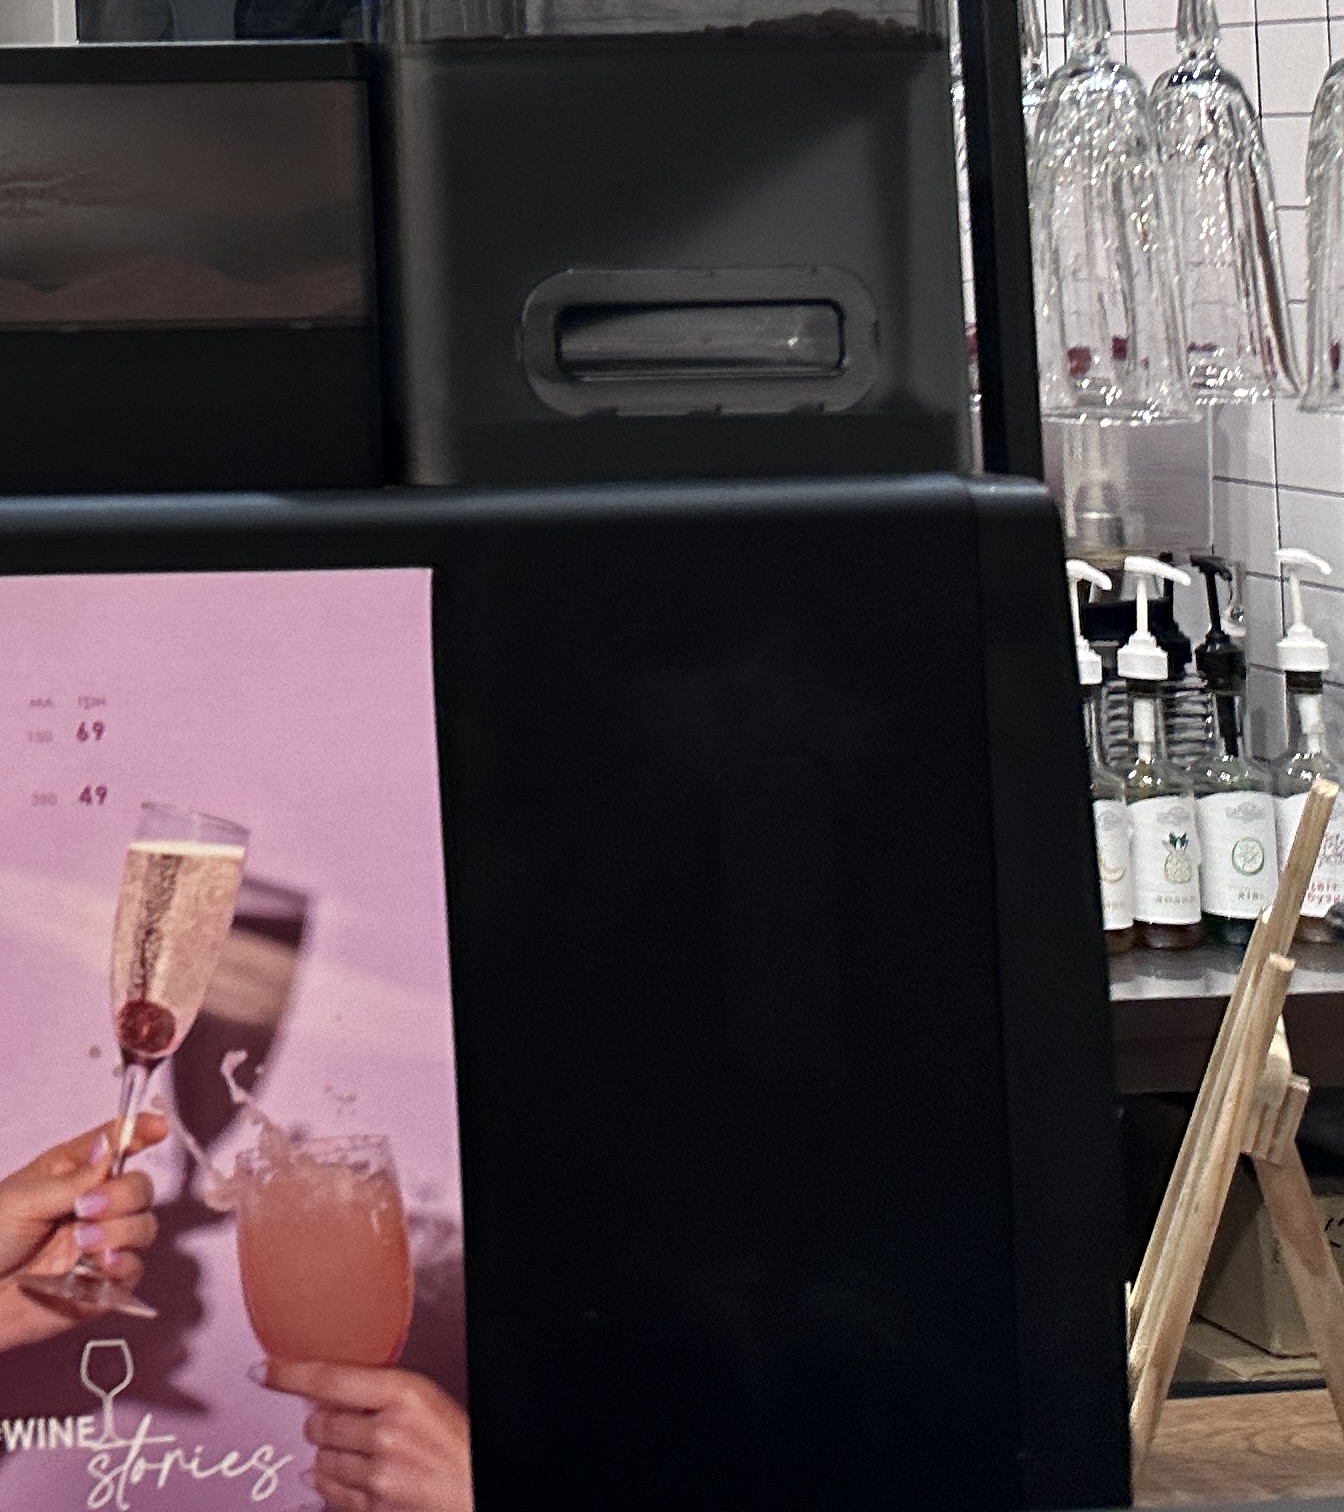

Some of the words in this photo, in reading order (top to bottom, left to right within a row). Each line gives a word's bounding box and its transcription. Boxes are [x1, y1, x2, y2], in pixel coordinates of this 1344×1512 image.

[76, 721, 105, 742] 69
[79, 785, 107, 805] 49
[86, 1413, 293, 1510] stories
